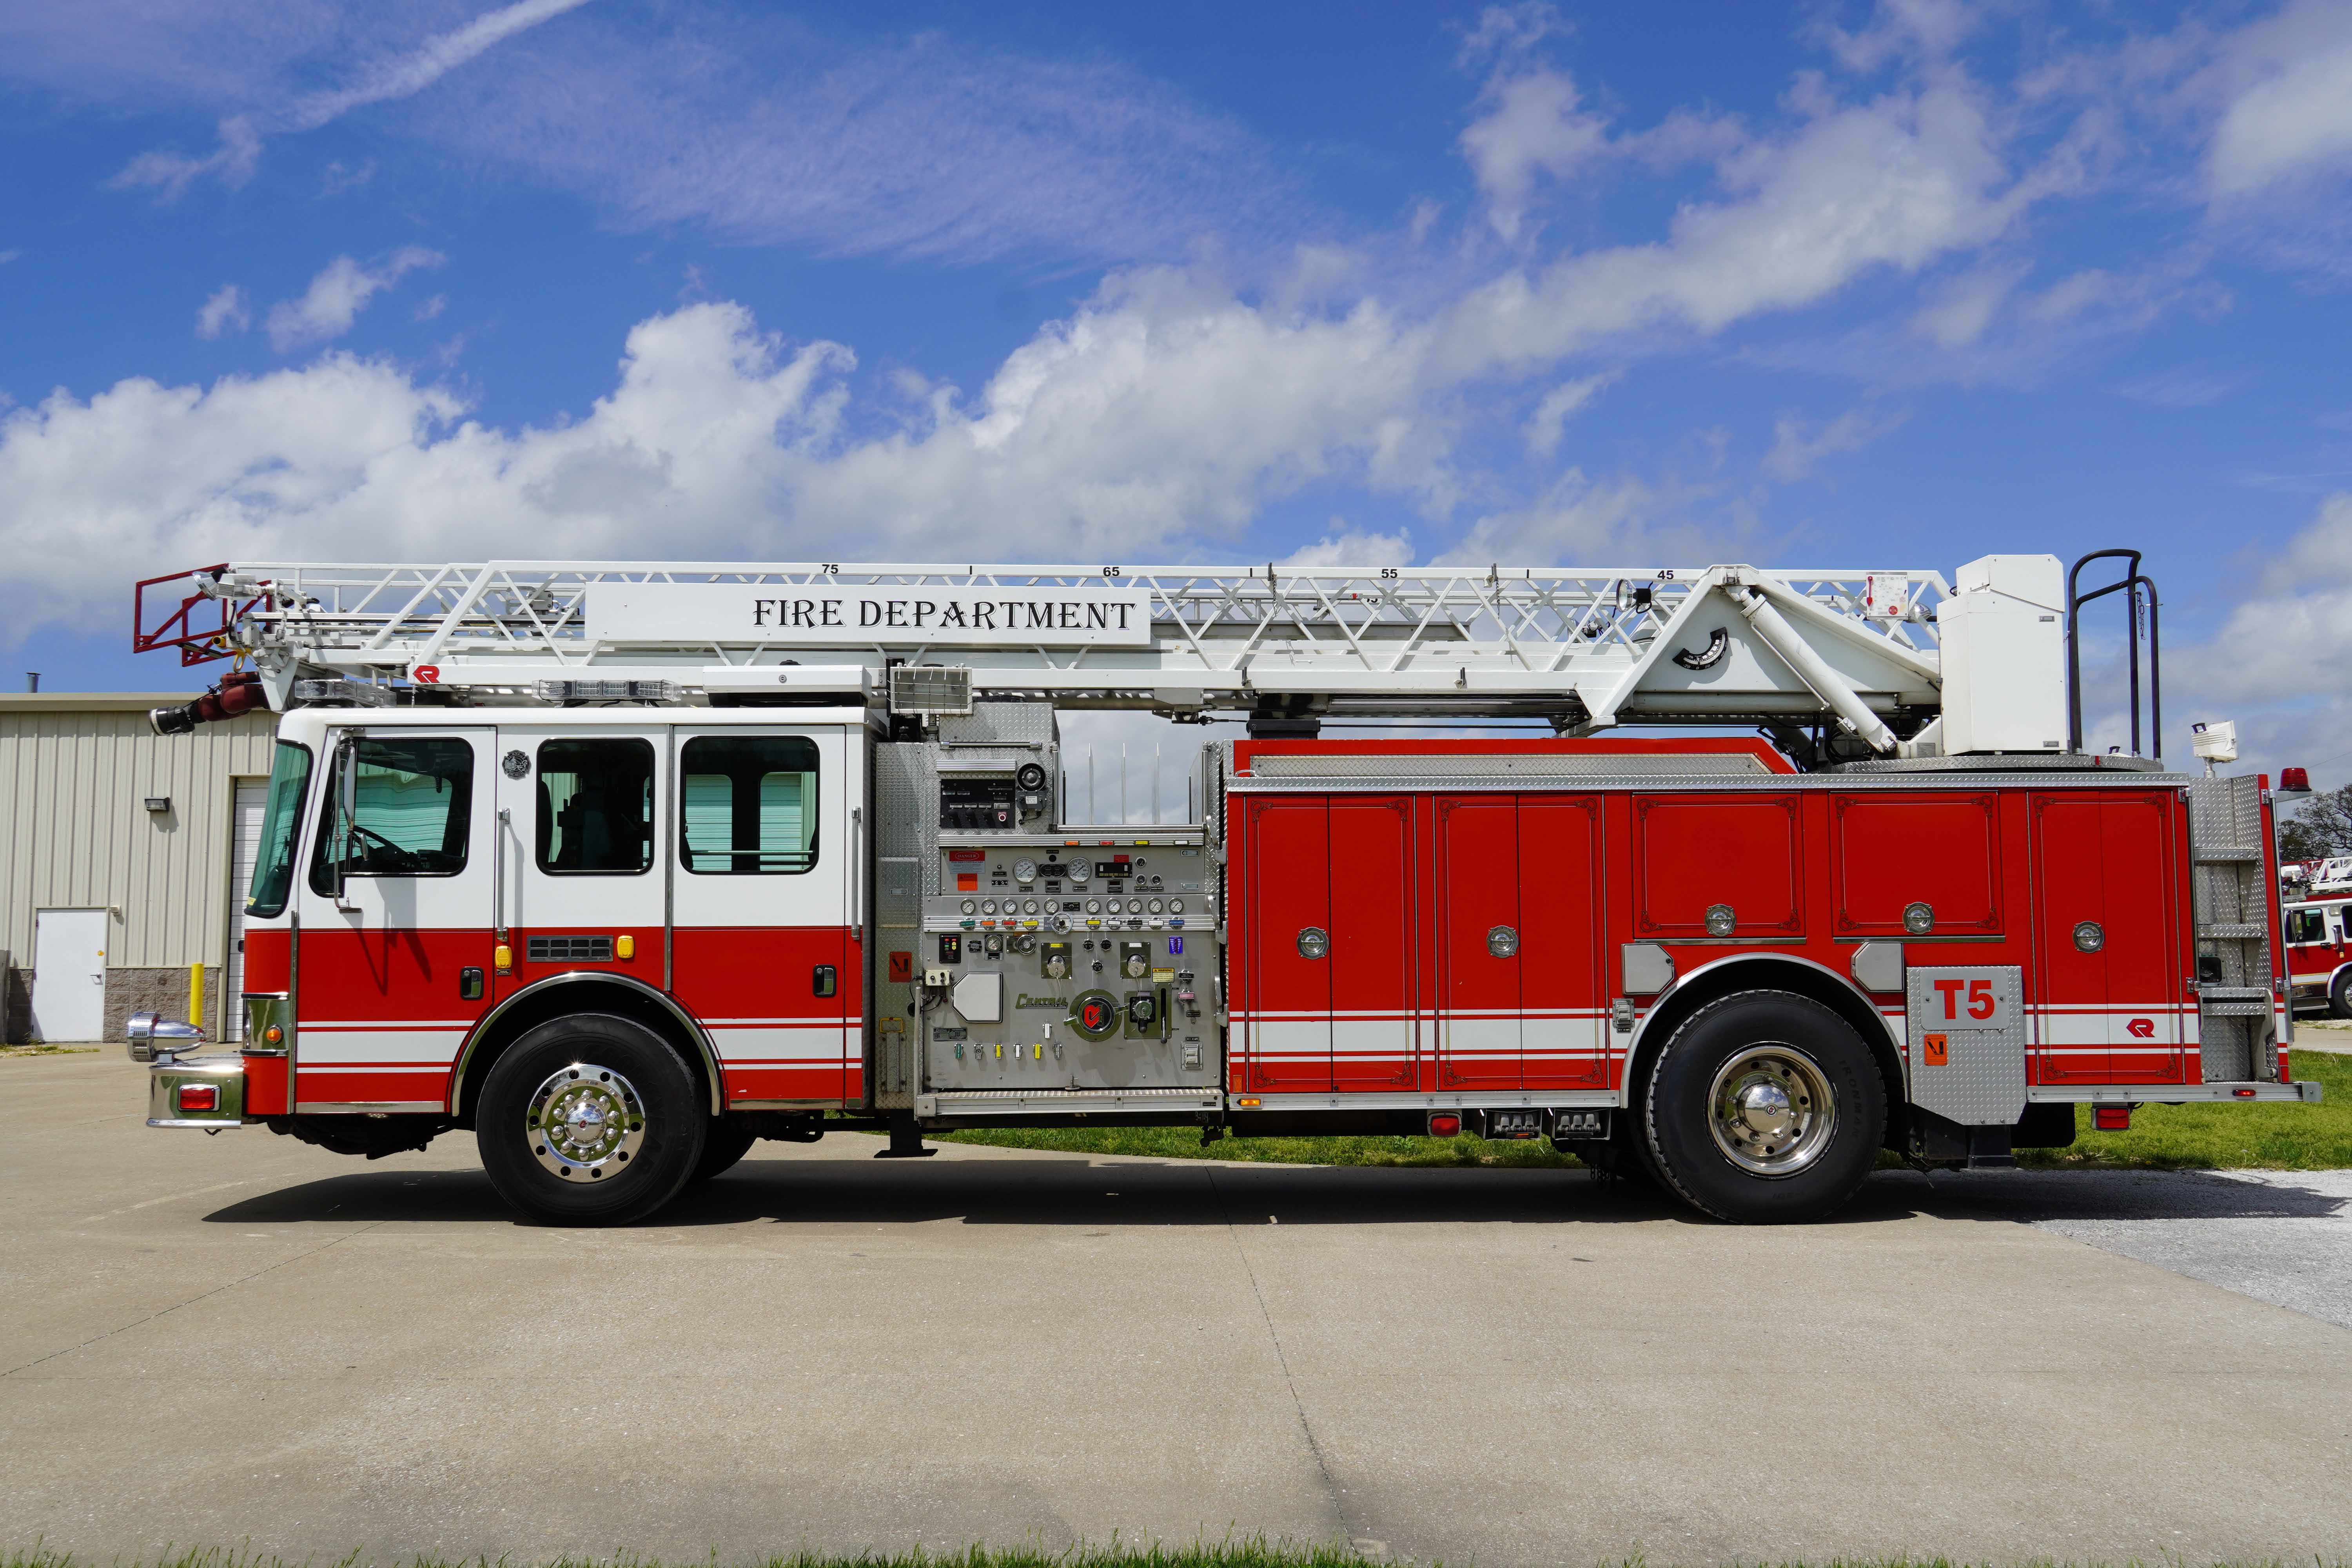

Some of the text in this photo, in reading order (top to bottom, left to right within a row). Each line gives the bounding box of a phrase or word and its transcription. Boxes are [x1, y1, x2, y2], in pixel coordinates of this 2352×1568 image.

[822, 564, 838, 574] 75
[1103, 566, 1120, 577] 65
[1381, 569, 1397, 579] 55
[1657, 570, 1674, 580] 45
[753, 600, 1136, 630] FIRE DEPARTMENT
[1015, 993, 1069, 1009] CENTRAL
[1934, 979, 1995, 1020] T5
[1838, 1060, 1863, 1138] IRONMAN
